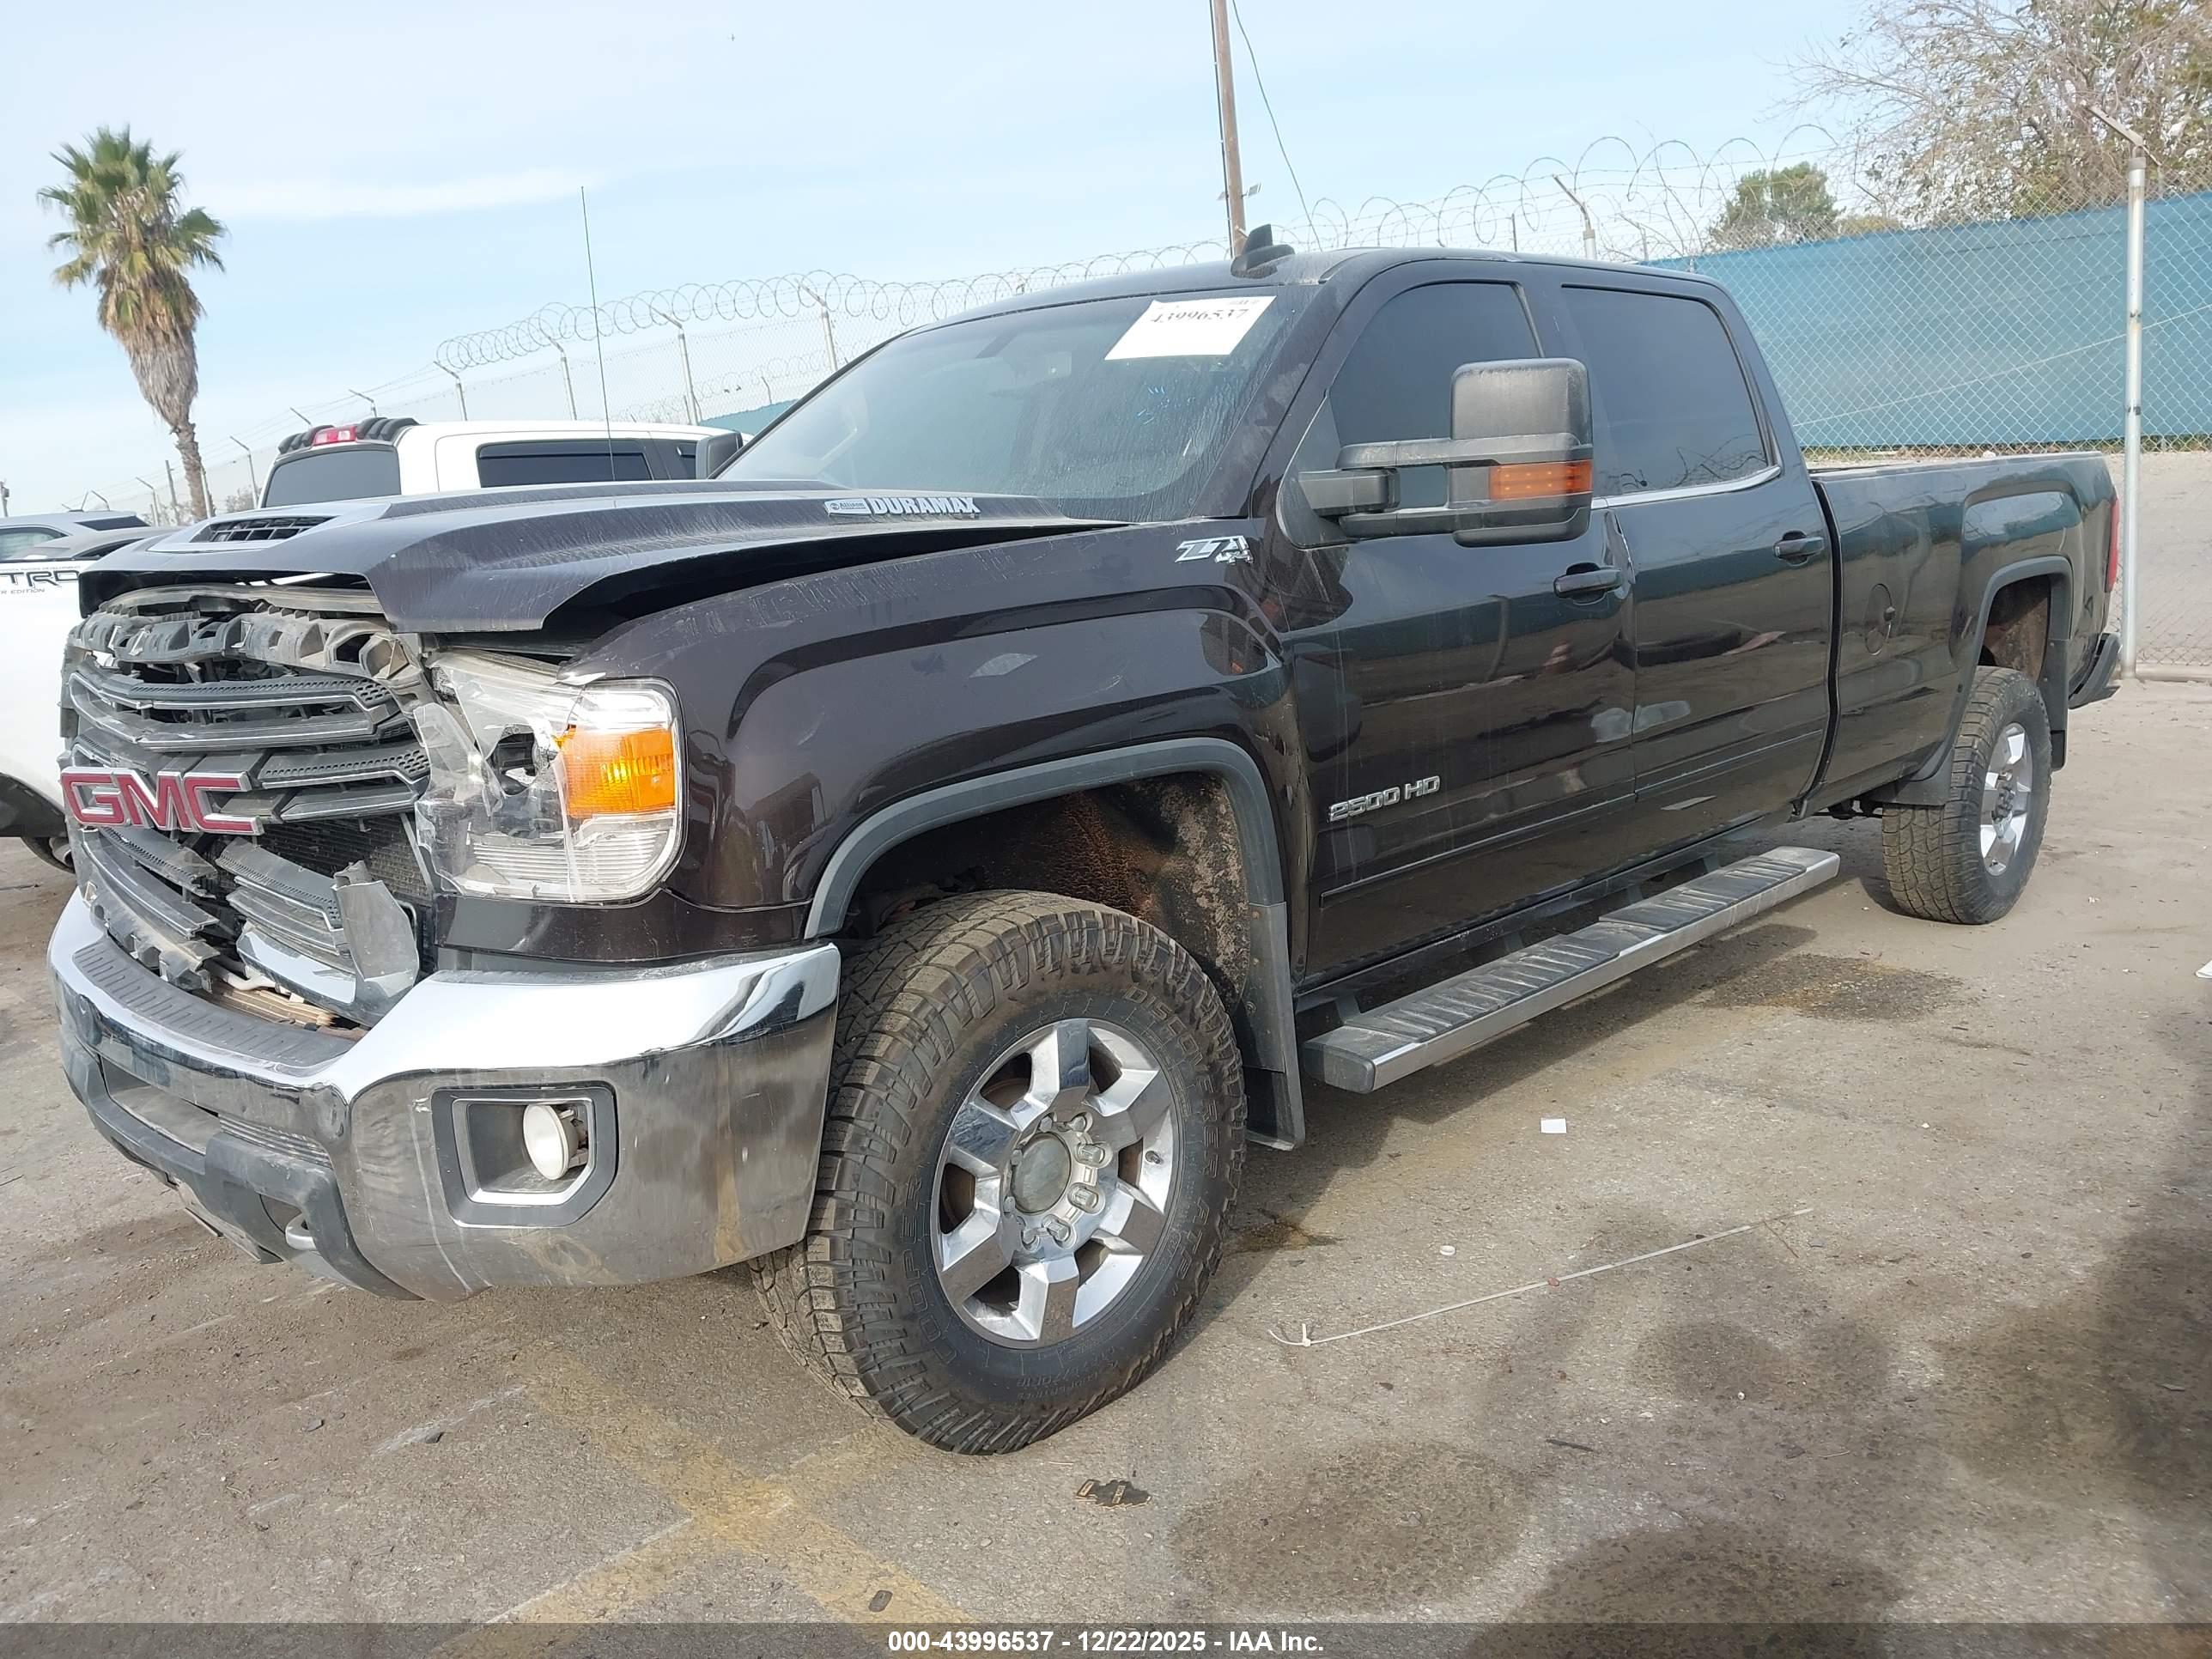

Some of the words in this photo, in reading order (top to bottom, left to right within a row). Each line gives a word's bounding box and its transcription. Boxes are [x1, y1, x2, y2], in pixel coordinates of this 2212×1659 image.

[866, 497, 981, 515] DURAMAX
[0, 570, 80, 586] TRD
[61, 766, 264, 836] GMC
[1329, 786, 1401, 822] 2500
[1405, 775, 1441, 800] HD
[902, 1175, 957, 1364] COOPER
